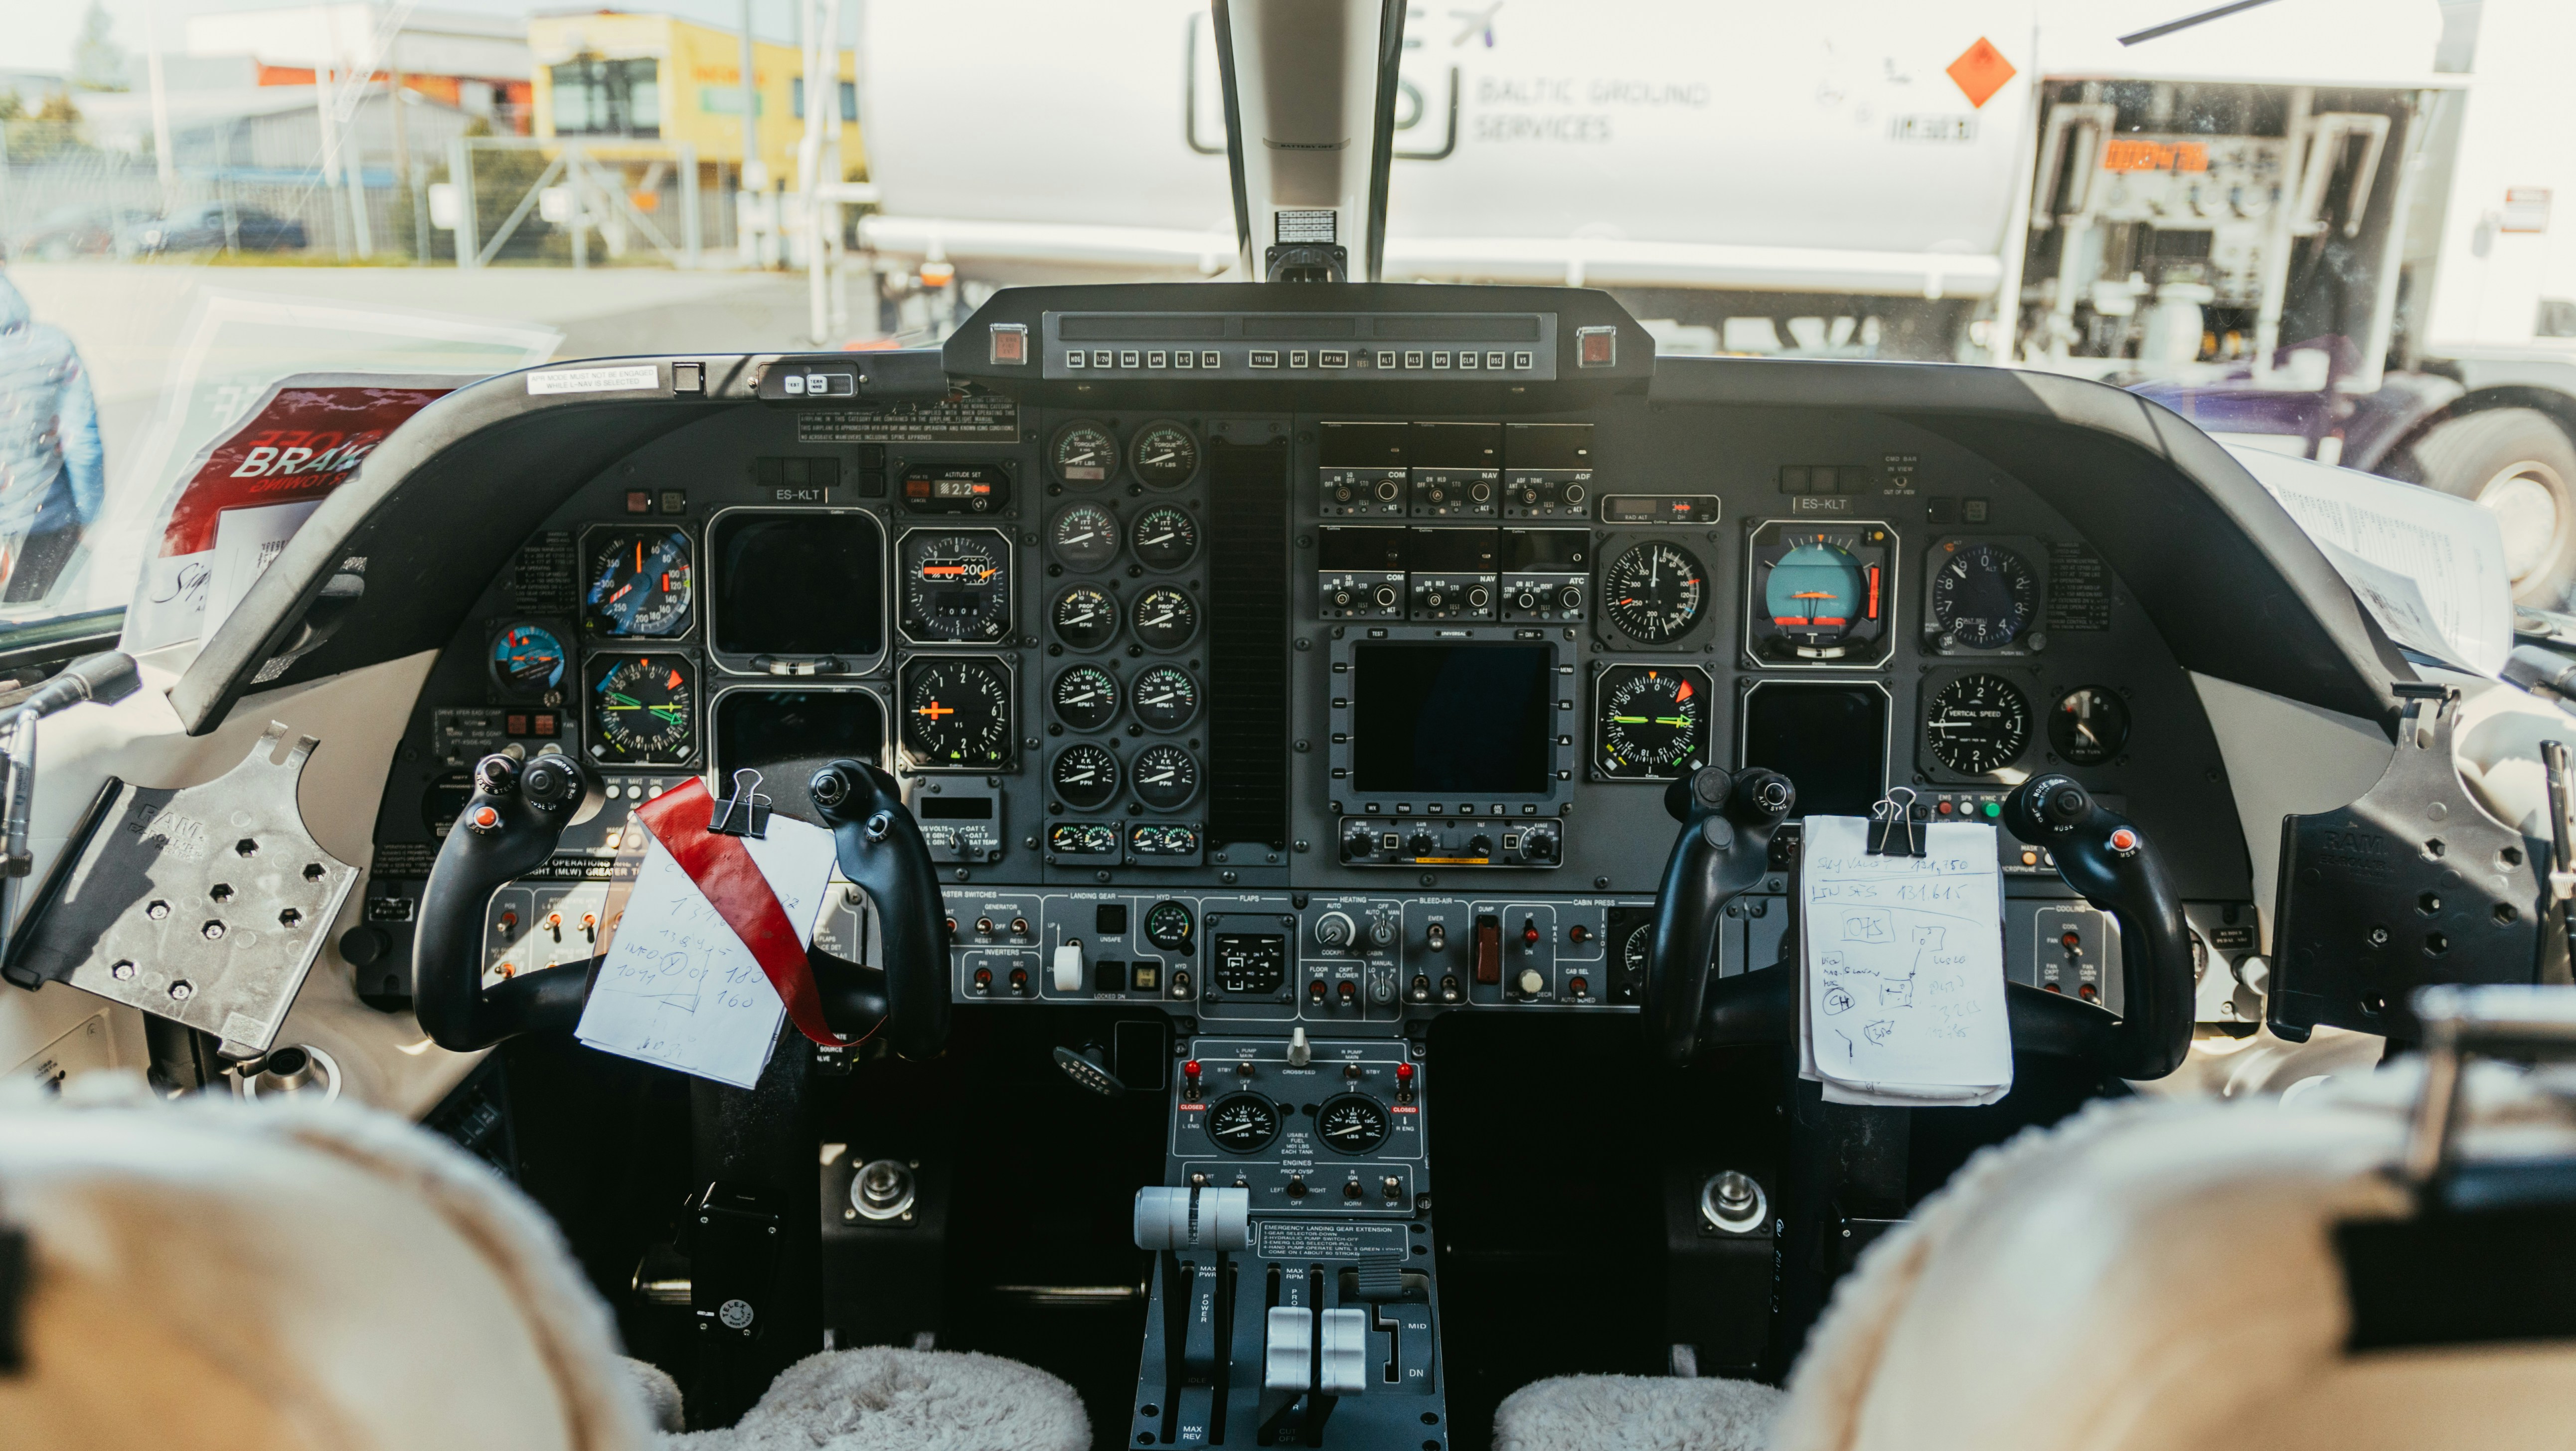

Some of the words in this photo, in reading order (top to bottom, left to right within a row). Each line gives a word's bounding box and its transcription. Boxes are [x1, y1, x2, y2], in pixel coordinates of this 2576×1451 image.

[1479, 78, 1573, 105] BALTIC
[1594, 80, 1708, 107] GROUND
[1473, 115, 1611, 143] SERVICES
[777, 490, 819, 499] ES-KLT
[1802, 499, 1847, 509] ES-KLT
[962, 565, 985, 576] 200
[602, 580, 615, 588] 300
[614, 603, 627, 612] 250
[636, 614, 648, 623] 200
[1758, 796, 1768, 806] A/P
[552, 859, 610, 868] OPERATIONS
[555, 868, 582, 877] (MLW)
[586, 868, 628, 876] GREATER
[725, 966, 765, 984] 180
[717, 990, 754, 1008] 160
[723, 1302, 746, 1317] TELEX
